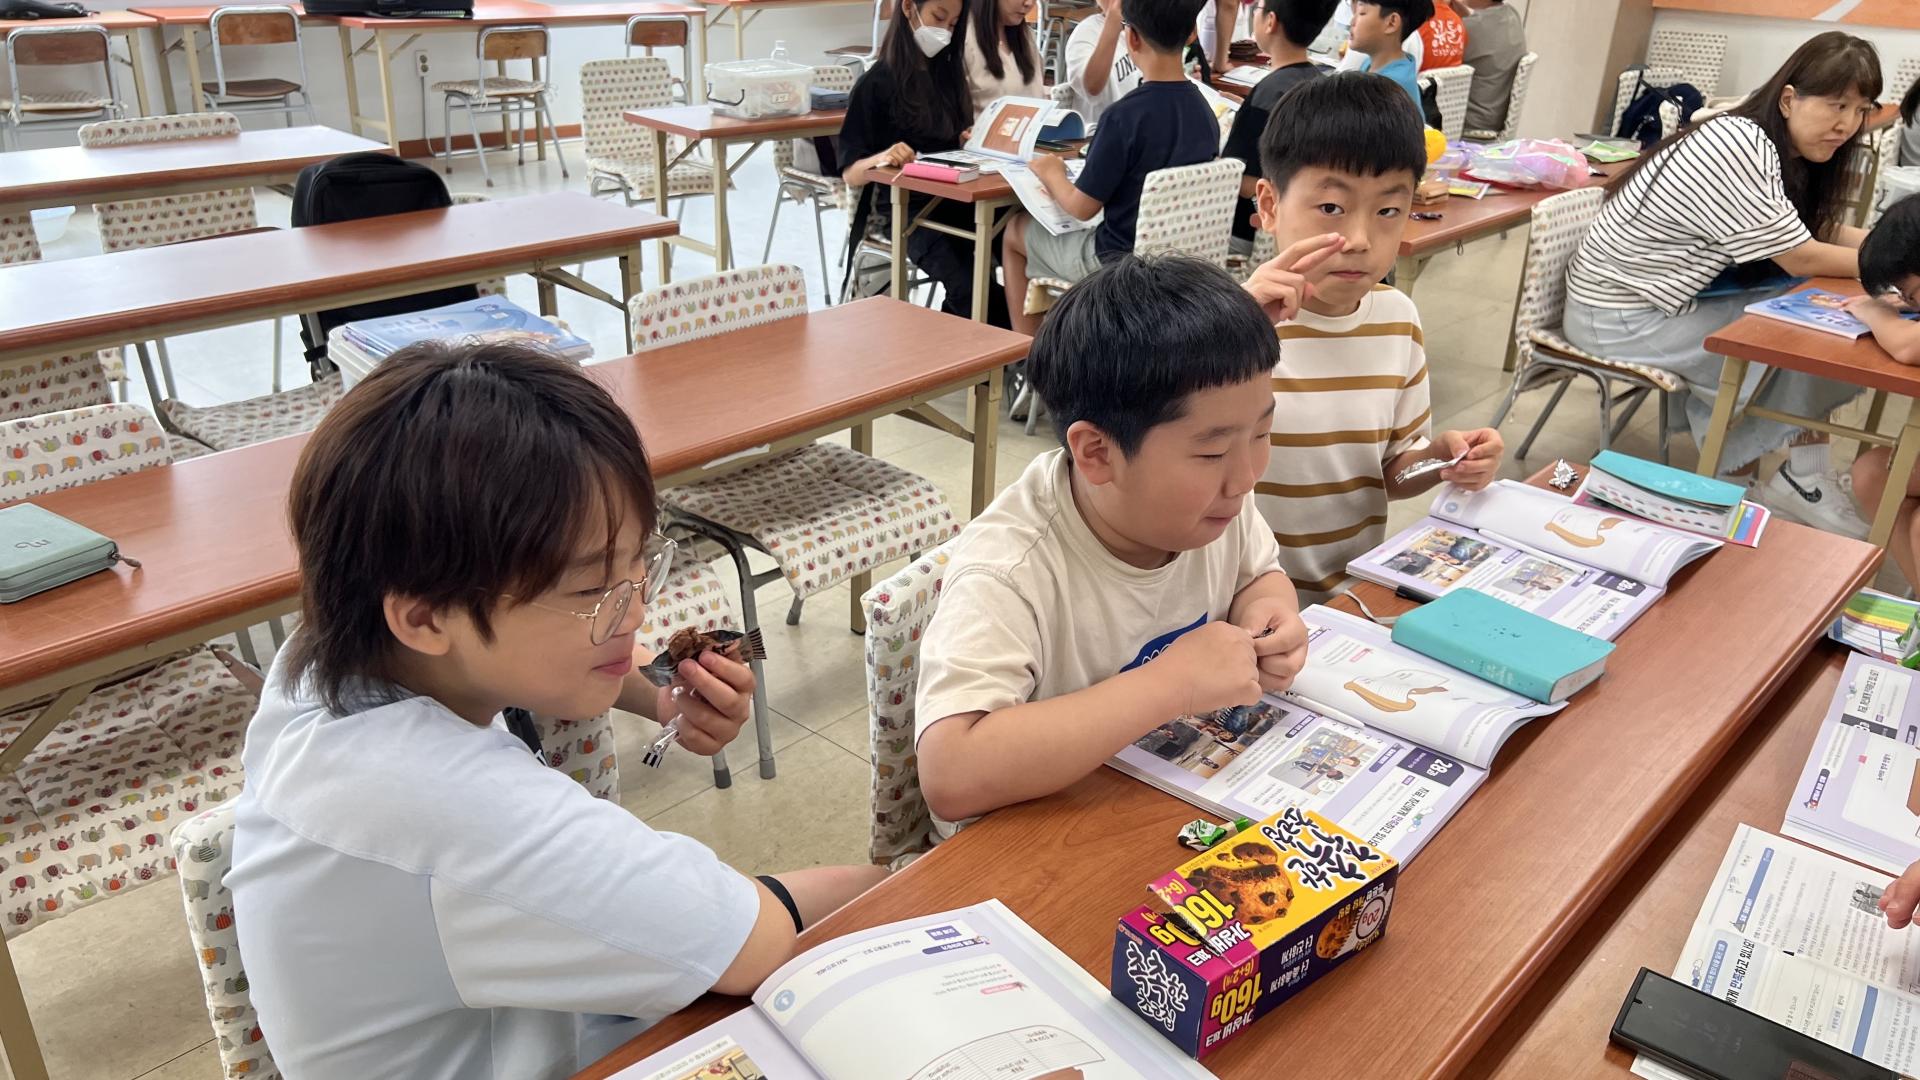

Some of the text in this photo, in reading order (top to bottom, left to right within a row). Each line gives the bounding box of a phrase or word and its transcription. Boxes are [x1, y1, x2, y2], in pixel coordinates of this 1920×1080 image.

[1262, 807, 1319, 852] 초코칩
[1287, 828, 1381, 889] 촉촉한
[1362, 908, 1381, 925] 20g
[1126, 940, 1190, 1013] 촉촉한
[1730, 959, 1750, 990] 만족하고
[1136, 987, 1177, 1032] 초코칩
[1210, 972, 1264, 1024] 160g
[1222, 1009, 1255, 1041] 가성비
